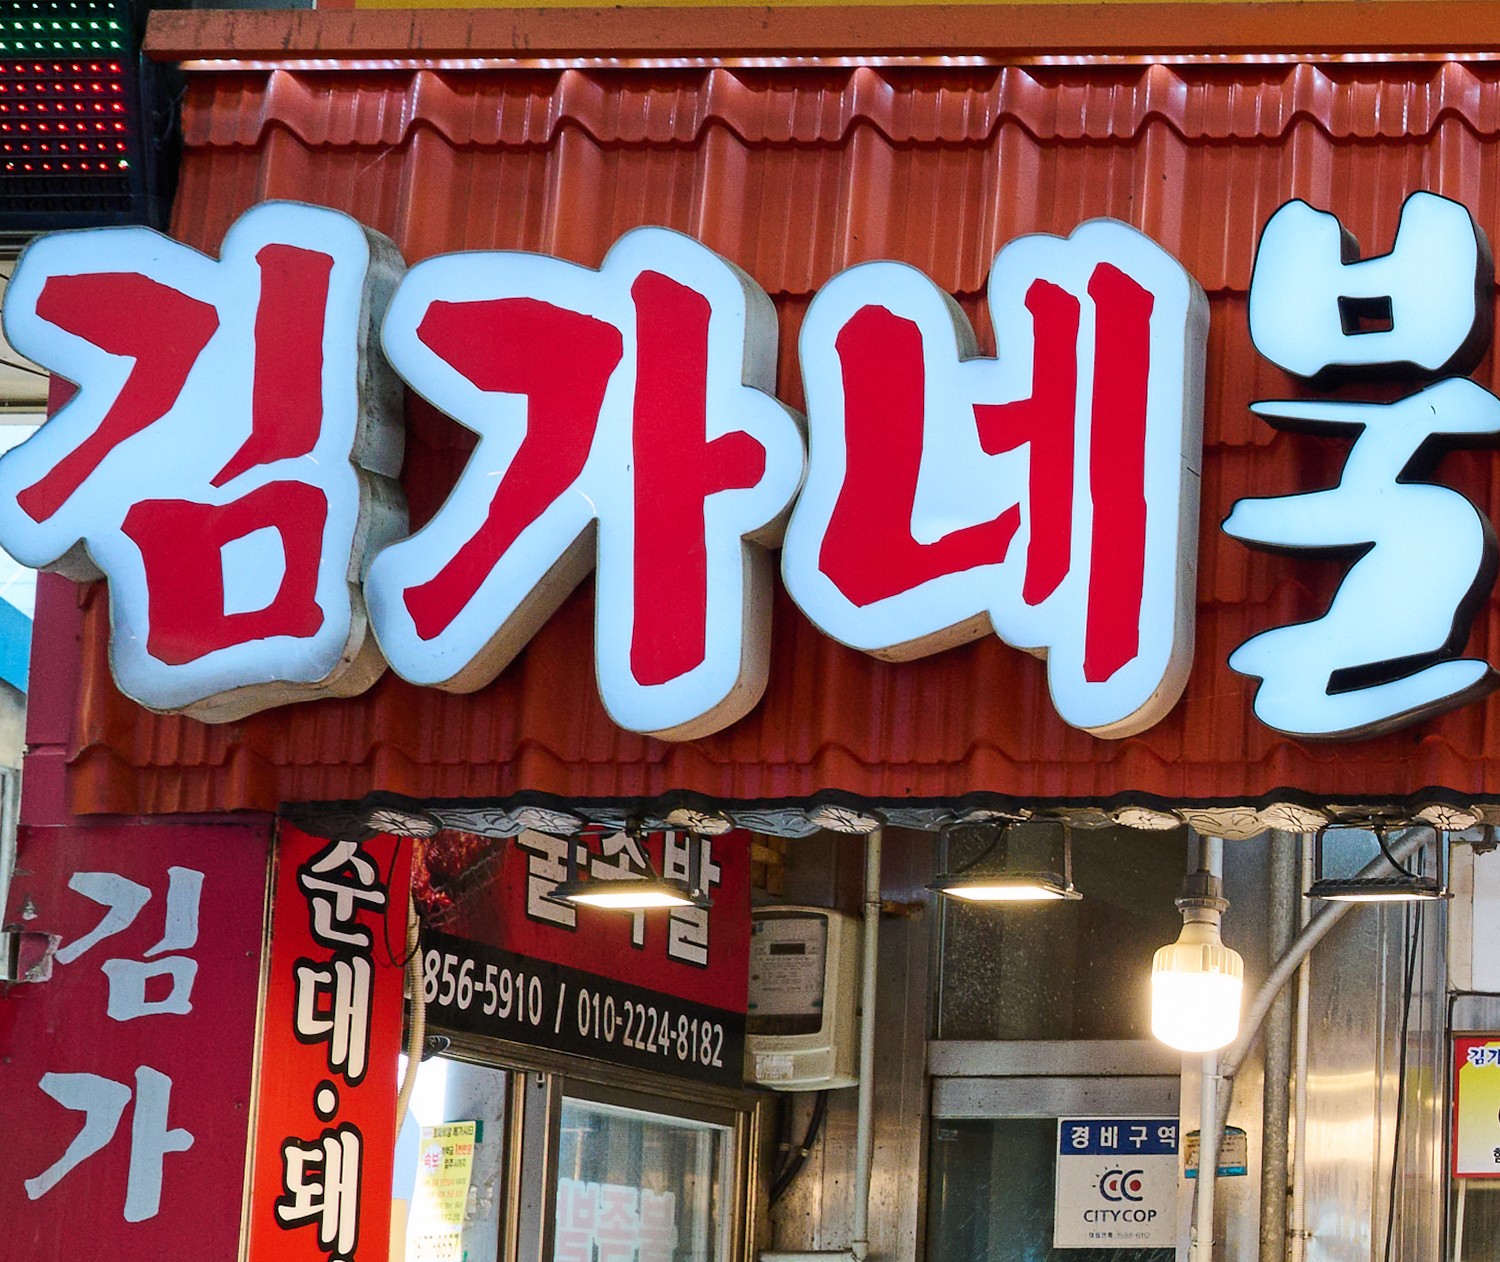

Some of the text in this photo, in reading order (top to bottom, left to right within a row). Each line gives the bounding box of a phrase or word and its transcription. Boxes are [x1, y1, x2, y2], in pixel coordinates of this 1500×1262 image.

[4, 206, 1195, 736] 김가네
[577, 988, 724, 1068] 010-2224-8182
[1072, 1126, 1176, 1149] 경비구역
